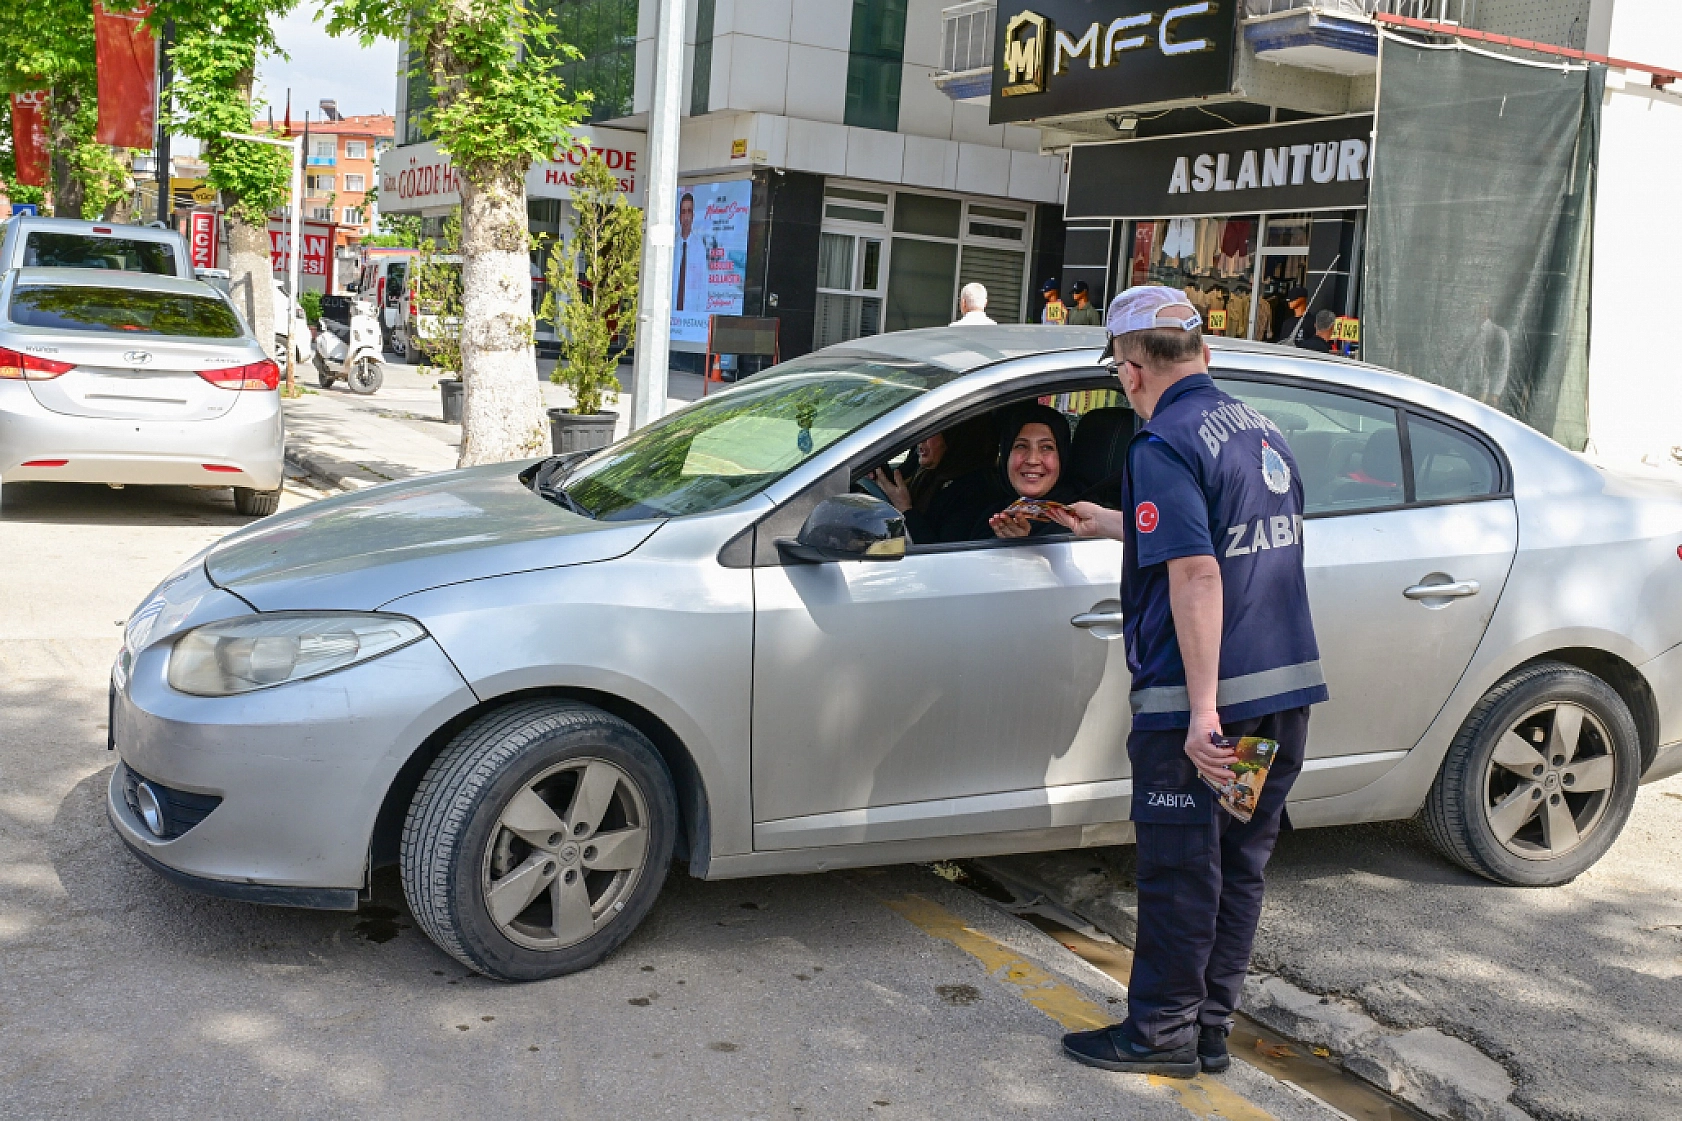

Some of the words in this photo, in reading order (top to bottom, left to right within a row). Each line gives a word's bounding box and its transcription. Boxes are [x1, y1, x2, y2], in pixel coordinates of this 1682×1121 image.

[1053, 2, 1214, 76] MFC
[398, 155, 440, 199] GÖZDE
[1167, 137, 1374, 194] ASLANTÜR
[1147, 792, 1196, 808] ZABITA
